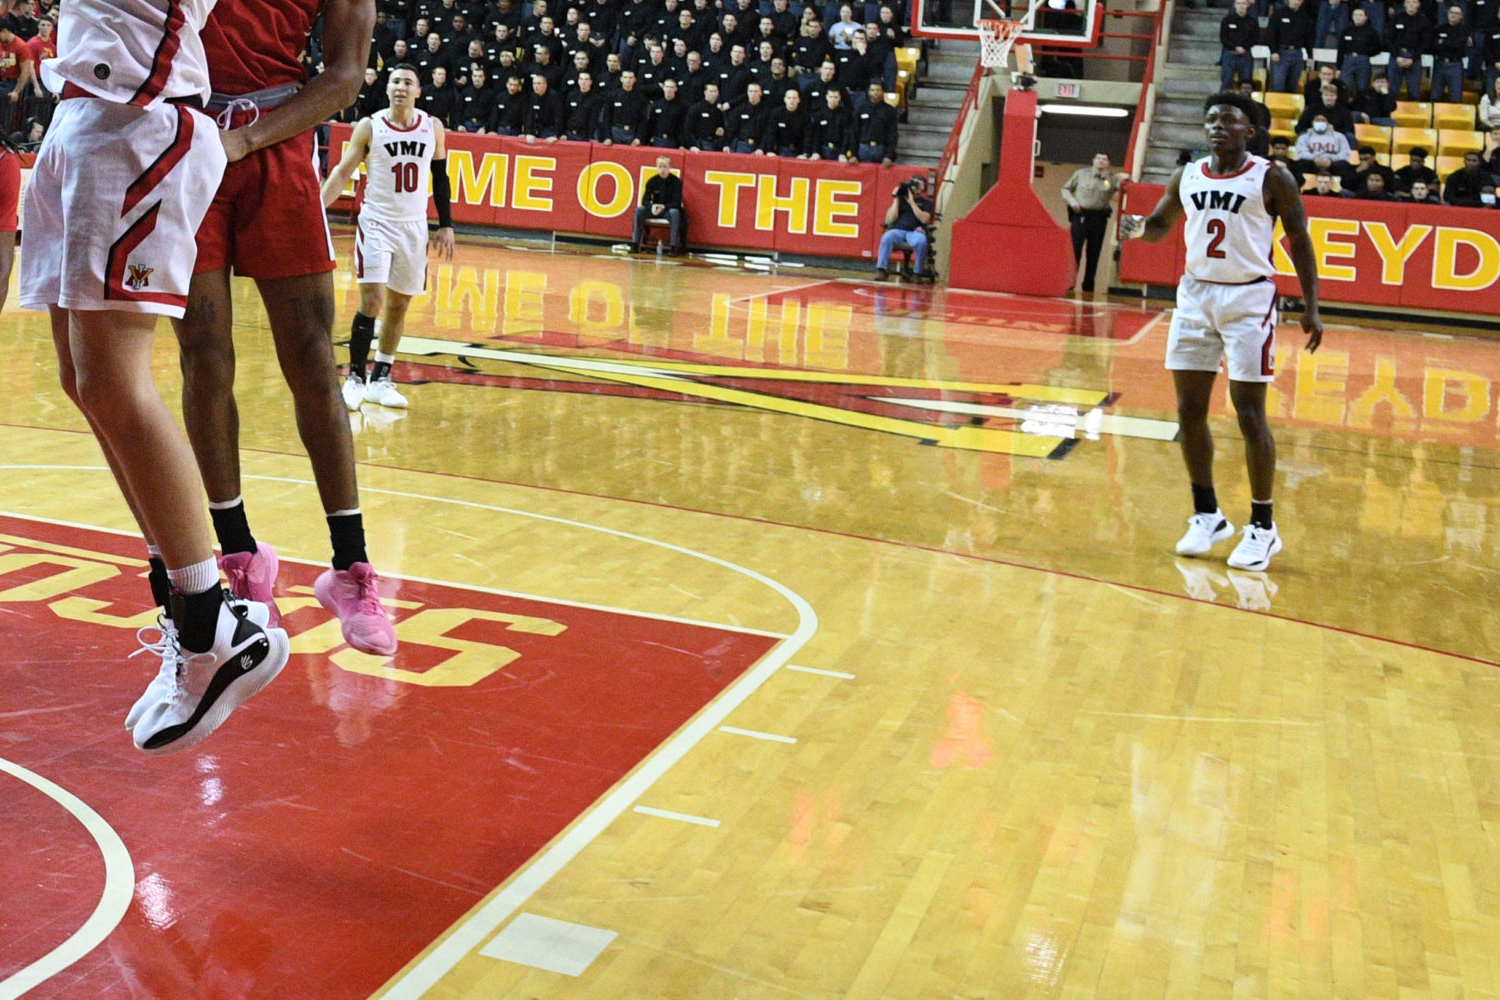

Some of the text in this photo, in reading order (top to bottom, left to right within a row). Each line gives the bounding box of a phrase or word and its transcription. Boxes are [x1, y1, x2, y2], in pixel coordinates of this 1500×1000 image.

[384, 141, 427, 157] VMI
[391, 162, 419, 193] 10
[704, 171, 862, 239] THE
[1190, 190, 1247, 214] VMI
[1206, 218, 1226, 259] 2
